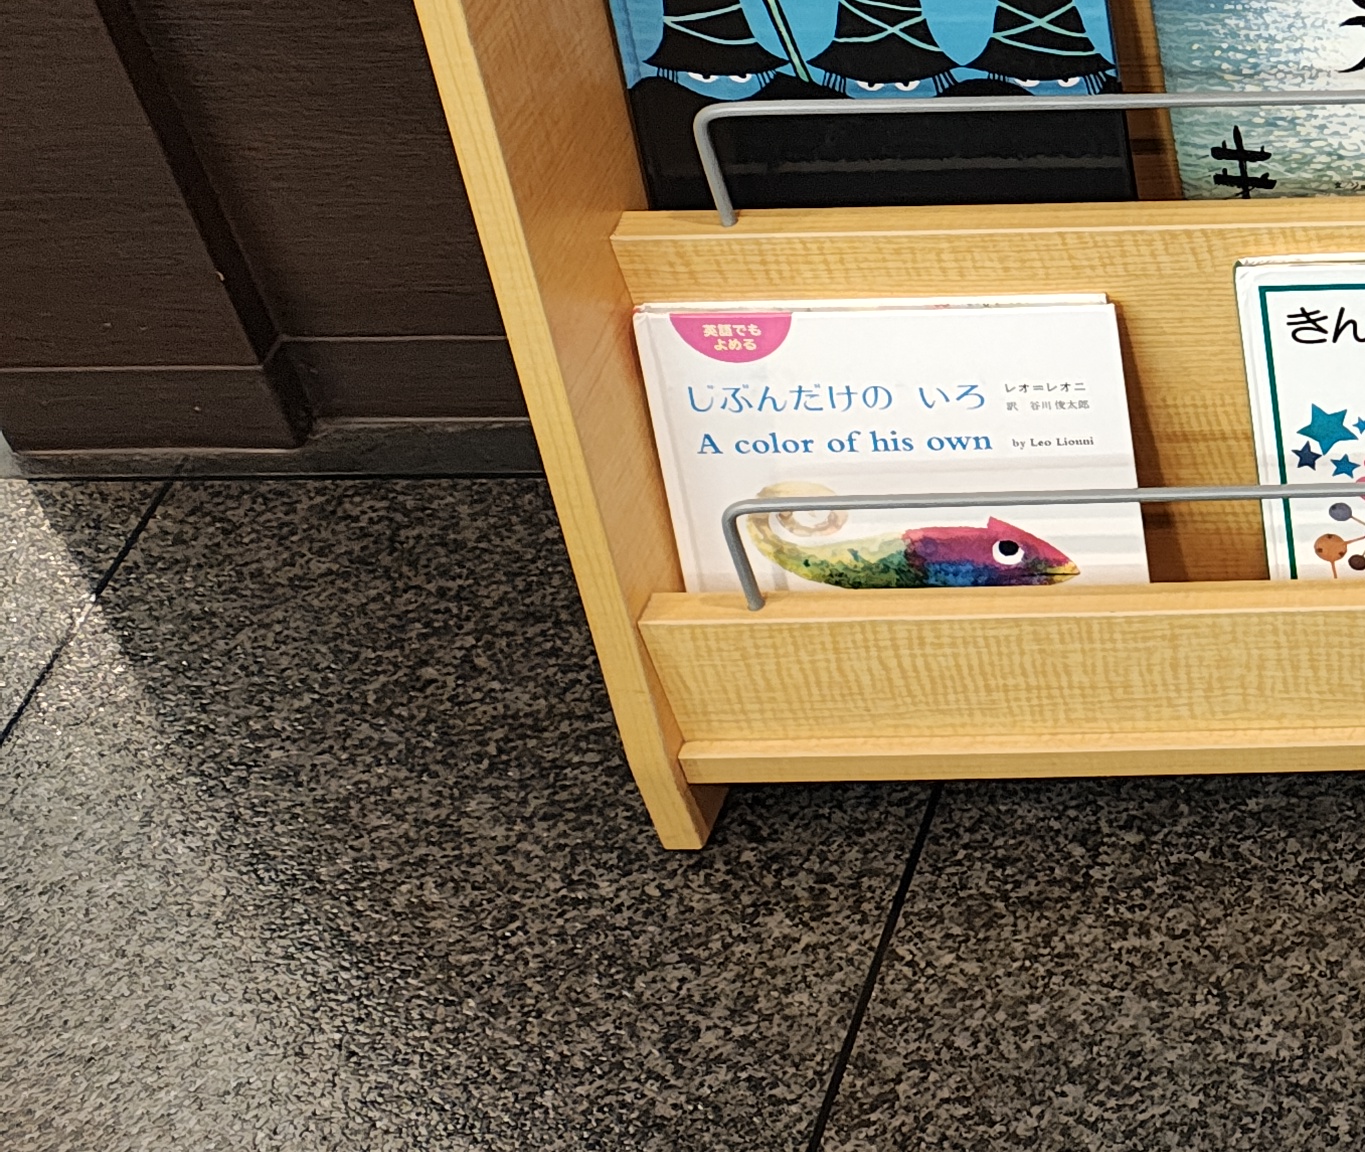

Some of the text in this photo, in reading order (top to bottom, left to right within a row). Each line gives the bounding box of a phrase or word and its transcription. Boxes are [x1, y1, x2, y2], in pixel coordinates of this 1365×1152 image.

[702, 324, 762, 337] 英語でも
[714, 338, 757, 352] よめる
[687, 383, 985, 413] じぶんだけの いろ
[697, 430, 992, 454] A color of his own
[1012, 436, 1094, 450] by Leo Lionni
